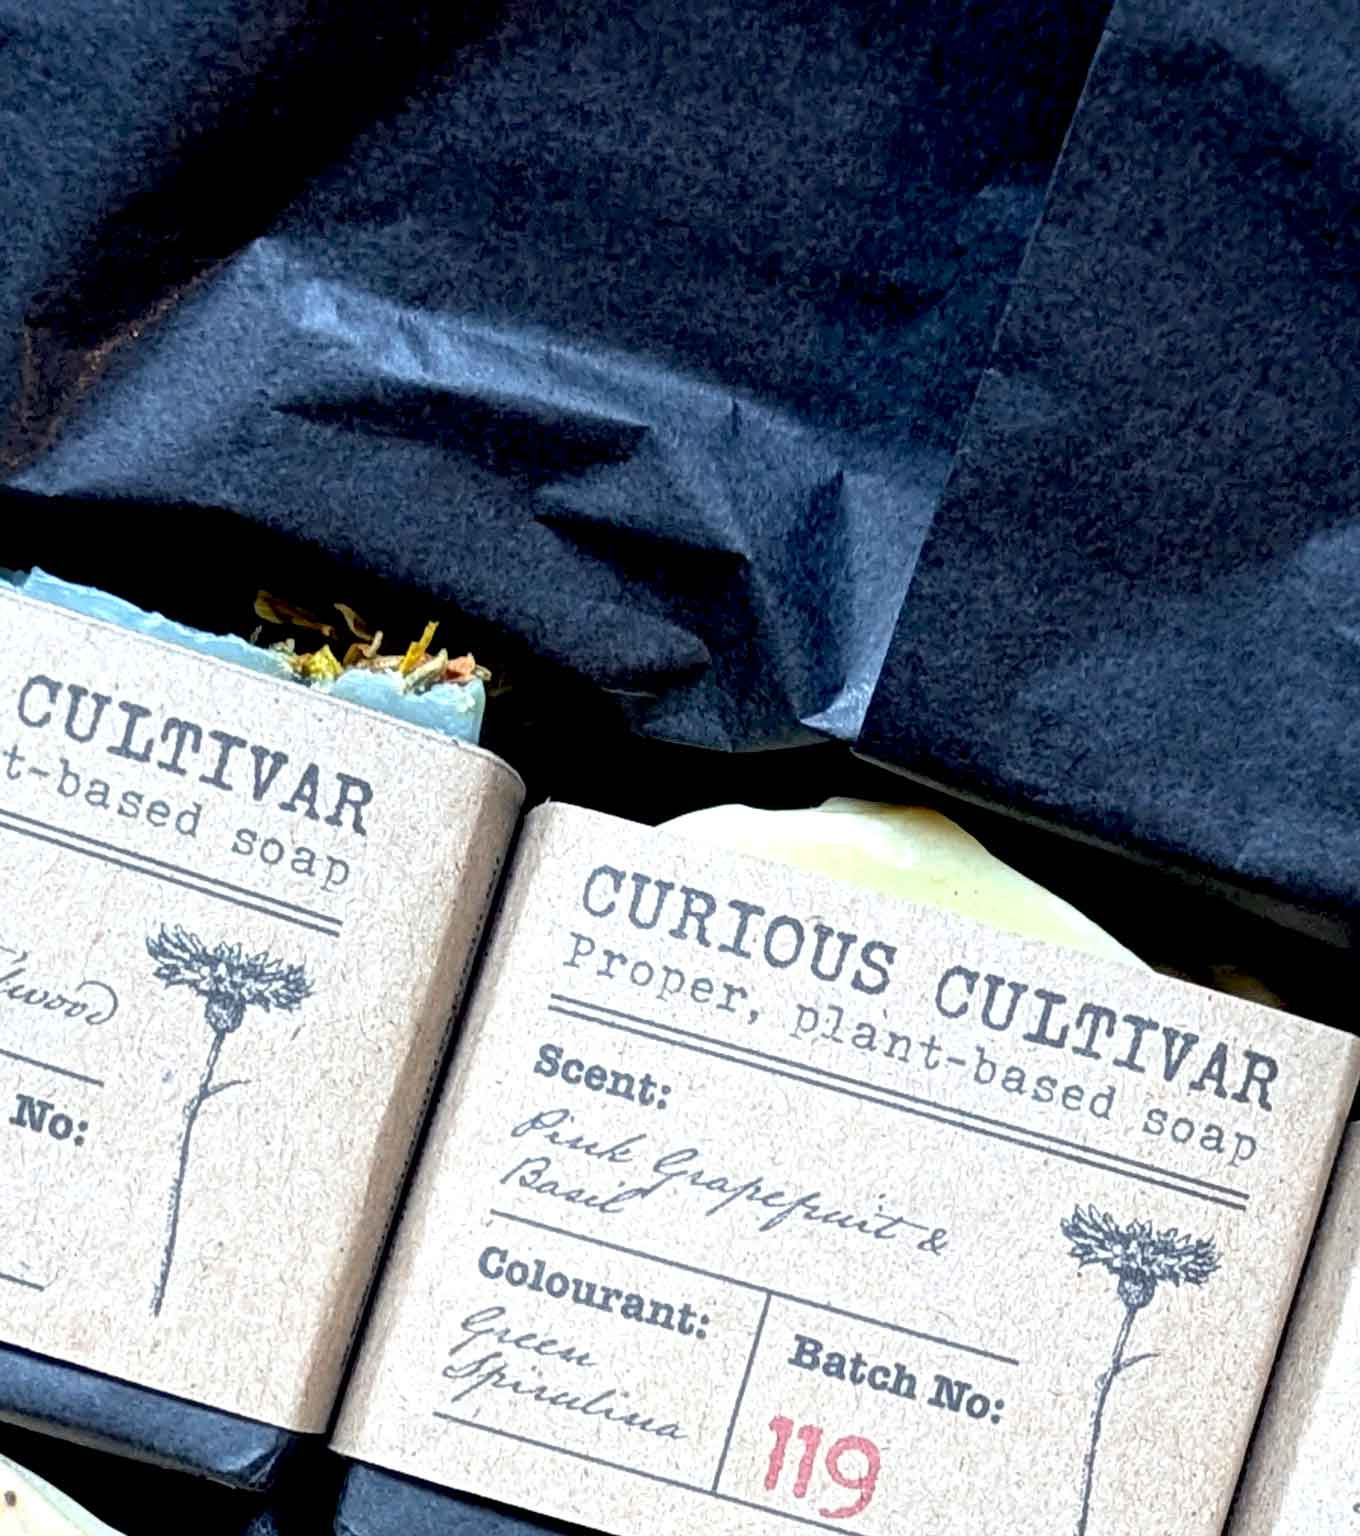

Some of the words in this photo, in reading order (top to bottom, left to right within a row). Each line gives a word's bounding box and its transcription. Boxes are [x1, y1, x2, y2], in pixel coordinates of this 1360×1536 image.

[16, 673, 374, 837] CULTIVAR
[230, 827, 350, 885] soap
[581, 863, 898, 996] CURIOUS
[933, 963, 1279, 1112] CULTIVAR
[532, 1042, 672, 1110] Scent:
[562, 930, 759, 1025] Proper,
[795, 1002, 1117, 1120] plant-based
[1141, 1107, 1257, 1167] soap
[7, 1092, 89, 1147] No:
[498, 1155, 640, 1213] Basil
[509, 1107, 638, 1163] Pink
[634, 1146, 919, 1239] Grapefruit
[916, 1227, 948, 1256] &
[448, 1305, 590, 1367] Green
[477, 1244, 710, 1340] Colourant:
[440, 1348, 680, 1440] Spirulina
[786, 1332, 917, 1401] Batch
[926, 1373, 1005, 1425] No:
[763, 1414, 881, 1519] 119
